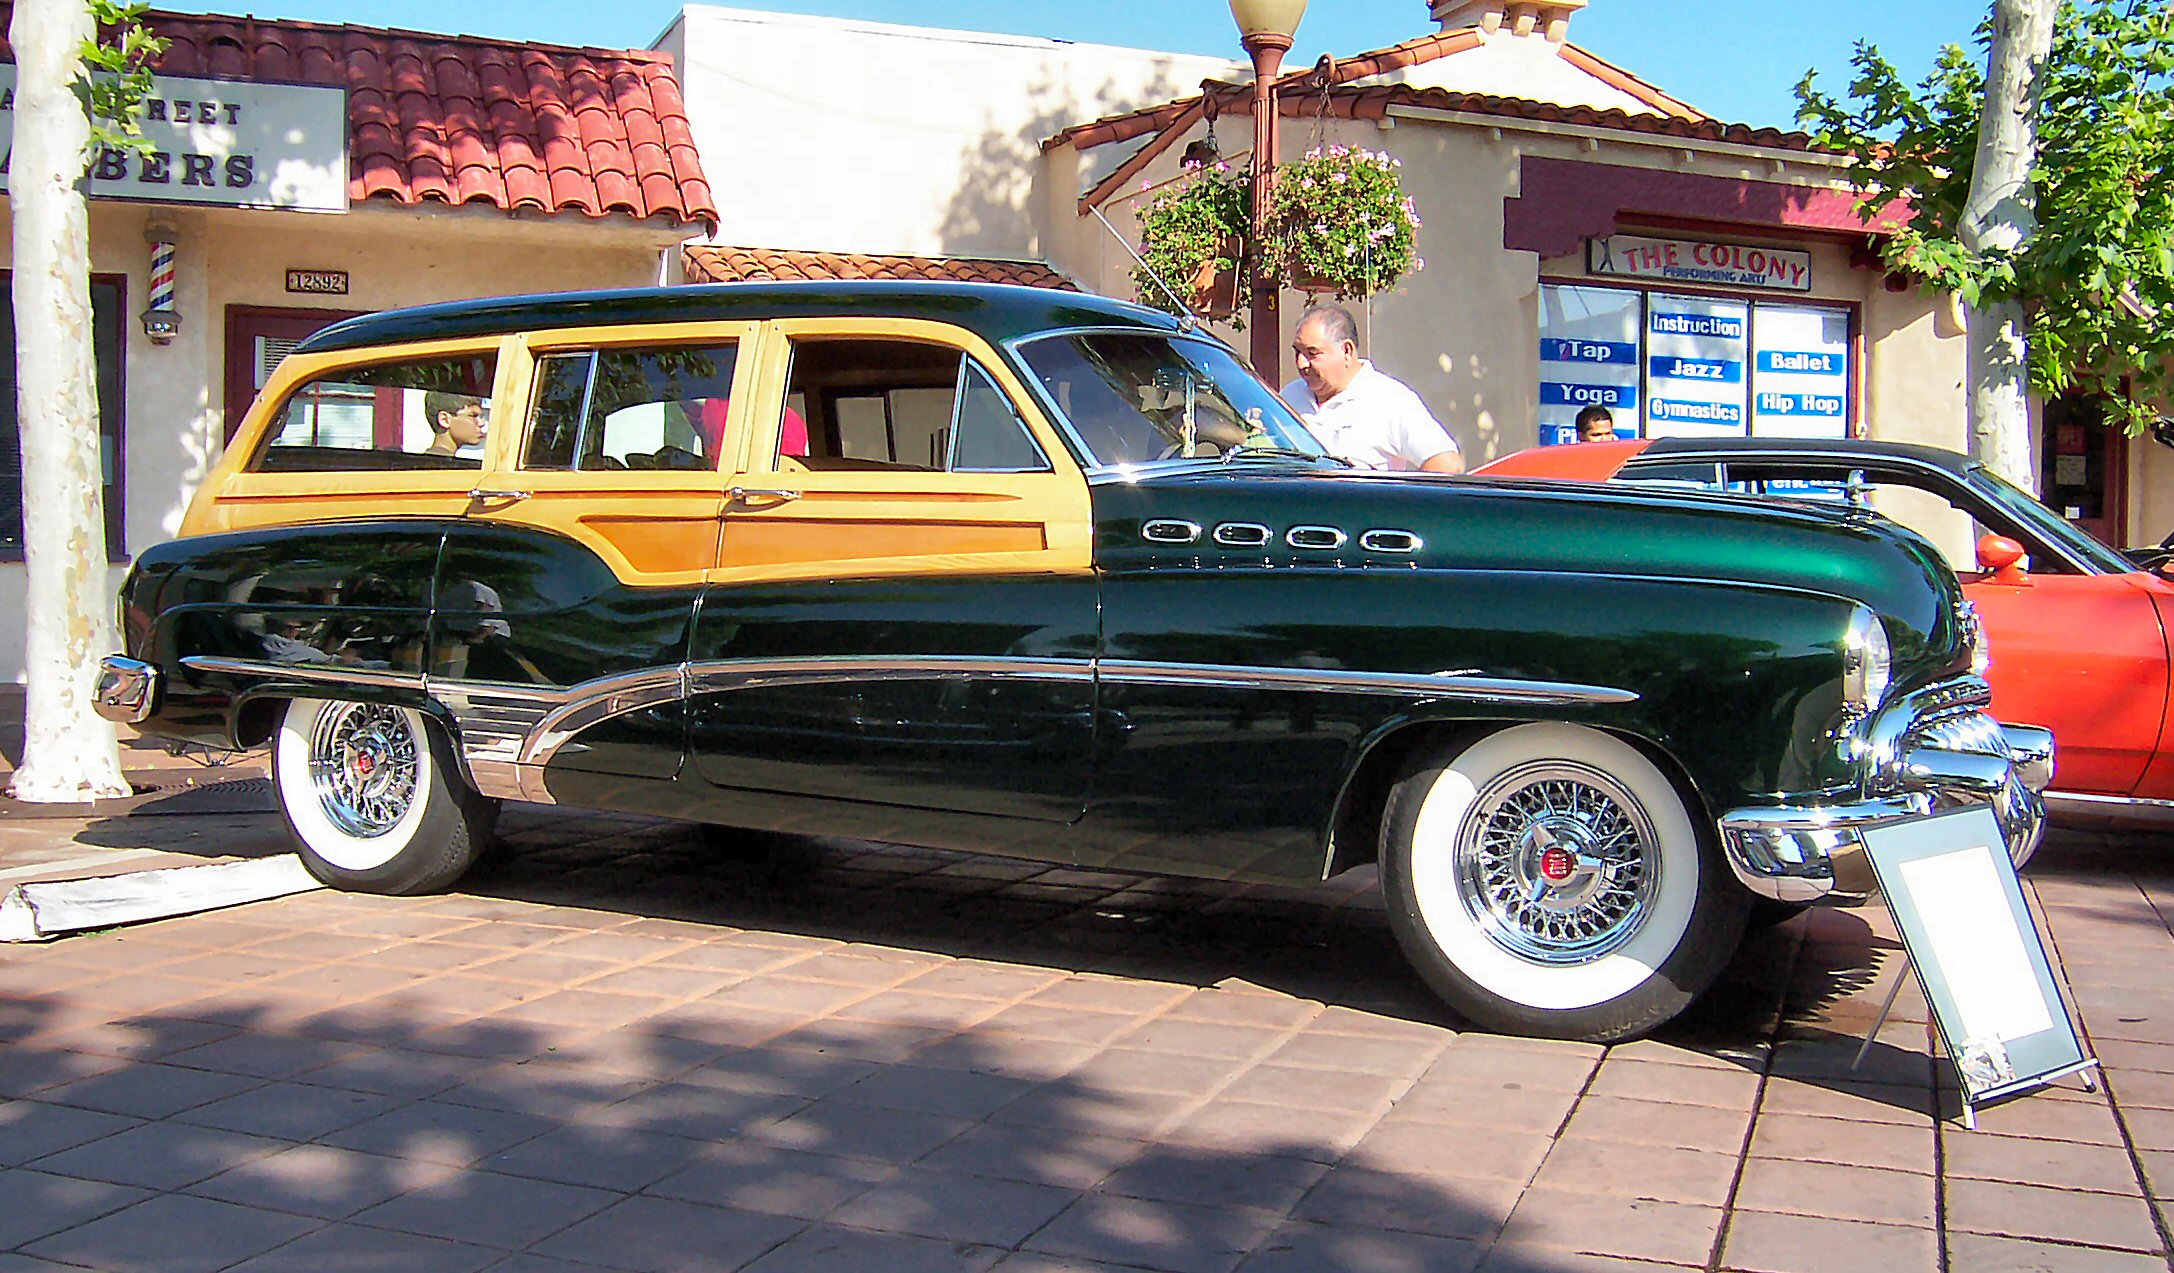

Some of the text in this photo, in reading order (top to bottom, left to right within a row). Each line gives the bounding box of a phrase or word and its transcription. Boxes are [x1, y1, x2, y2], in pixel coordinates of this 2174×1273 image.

[140, 98, 242, 126] REET
[45, 147, 254, 188] BERS
[1622, 243, 1806, 286] THE COLONY
[296, 273, 341, 289] 12892
[1268, 295, 1275, 310] 3
[1653, 314, 1741, 337] Instruction
[1568, 340, 1612, 362] Tap
[1770, 352, 1832, 371] Ballet
[1669, 359, 1725, 379] Jazz
[1561, 384, 1618, 405] Yoga
[1762, 393, 1840, 415] Hip Hop
[1652, 398, 1740, 421] Gymnastics
